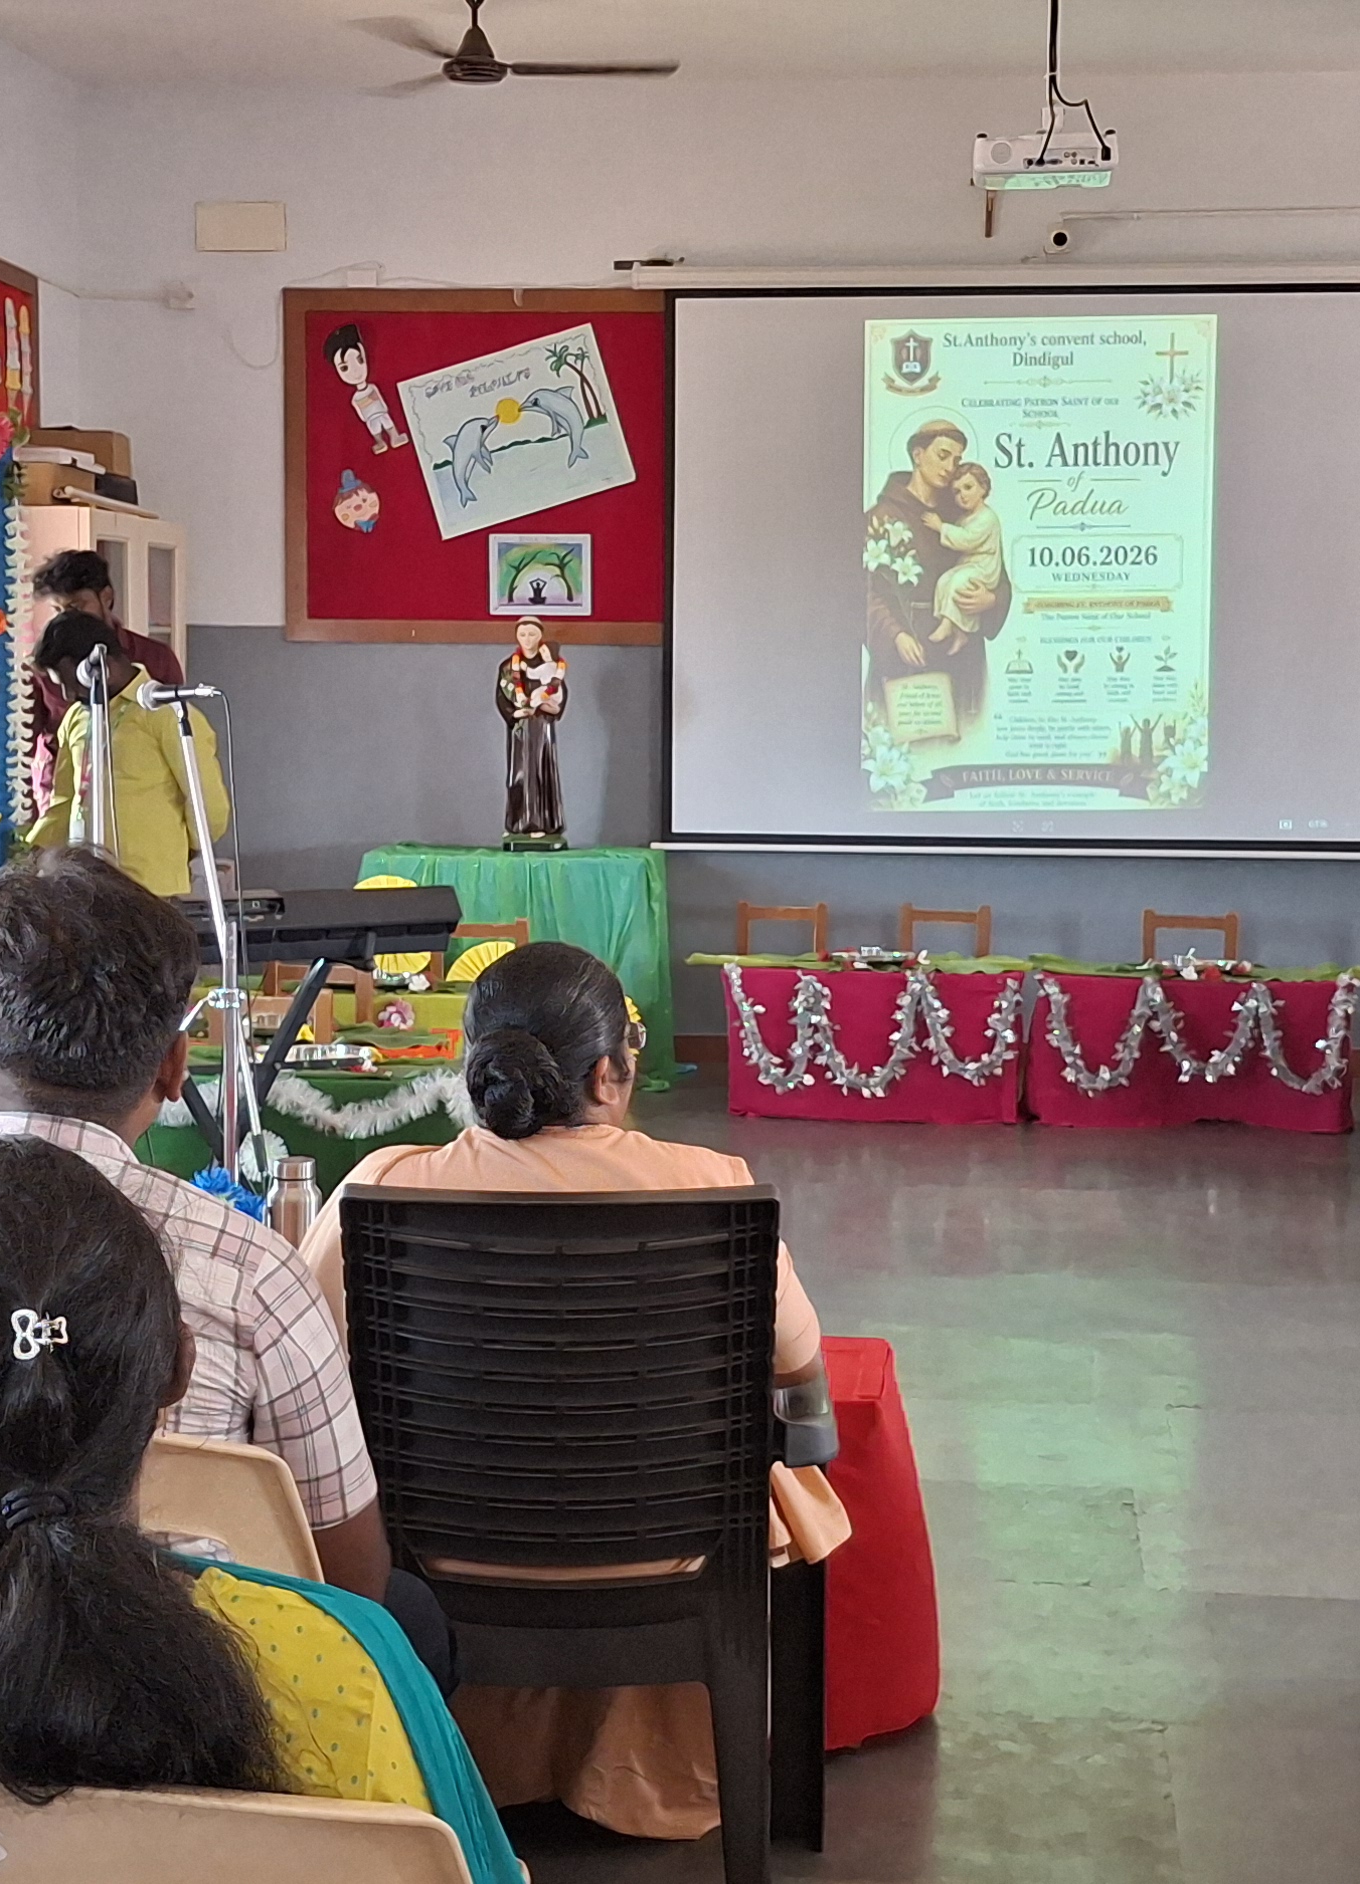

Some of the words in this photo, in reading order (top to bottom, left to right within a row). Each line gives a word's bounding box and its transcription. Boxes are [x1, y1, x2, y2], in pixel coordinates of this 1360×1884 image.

[1041, 333, 1094, 346] convent
[1012, 351, 1074, 370] Dindigul
[994, 432, 1034, 469] St.
[1045, 430, 1180, 477] Anthony
[1067, 471, 1085, 492] of
[1026, 487, 1129, 521] Padua
[1028, 545, 1158, 569] 10.06.2026
[1052, 572, 1131, 582] WEDNESDAY
[1009, 769, 1040, 780] LOVE
[1047, 768, 1056, 780] &
[1061, 769, 1112, 781] SERVICE
